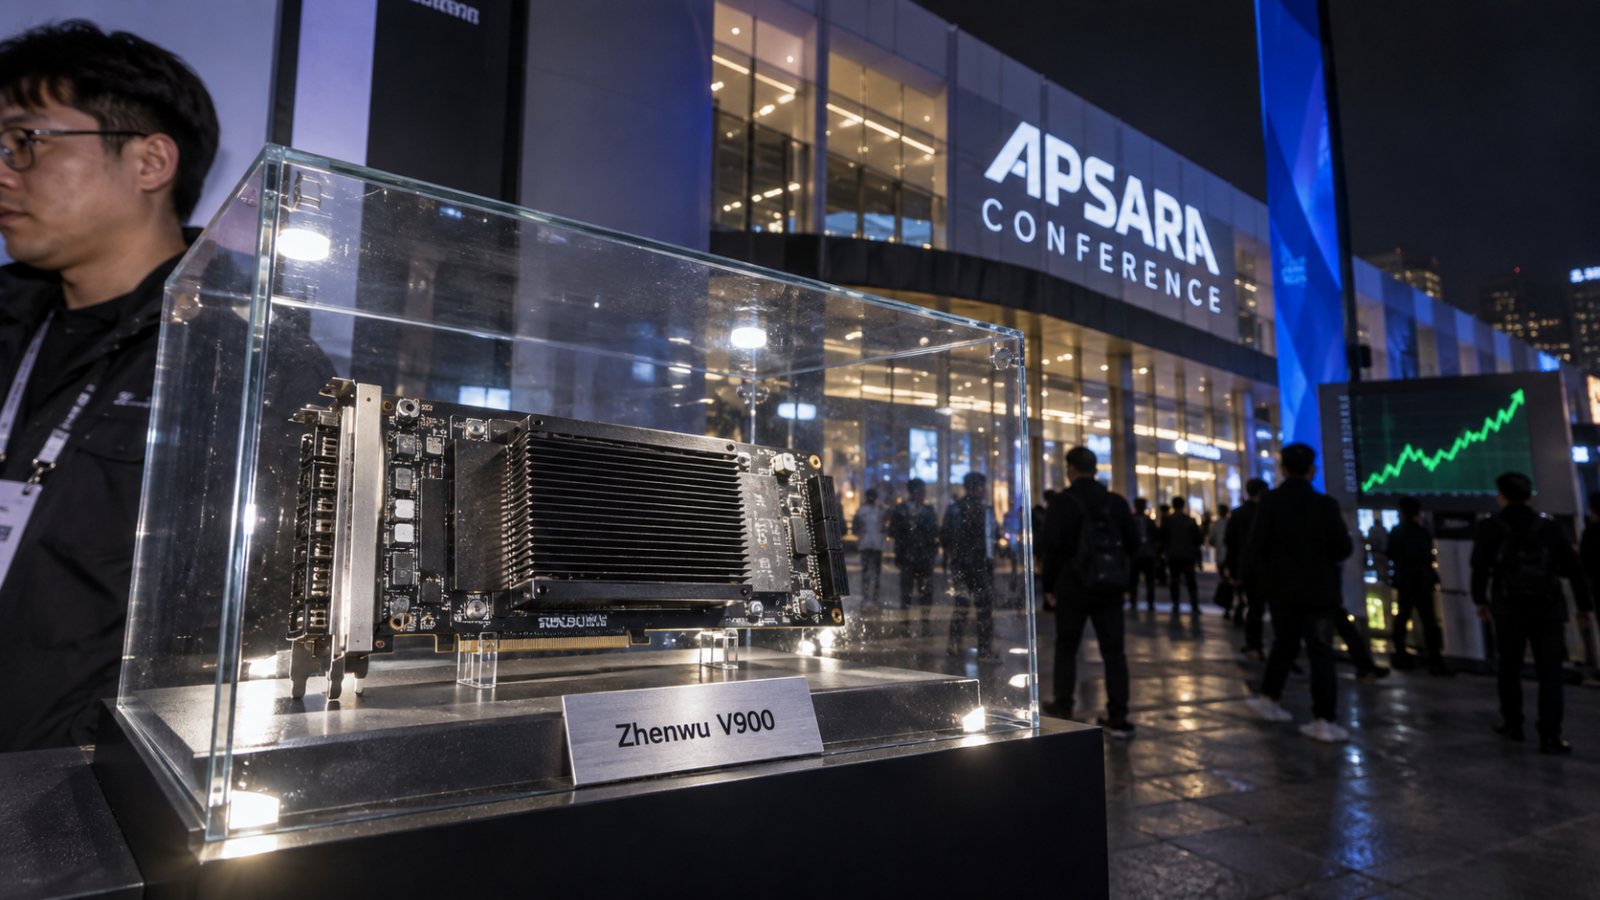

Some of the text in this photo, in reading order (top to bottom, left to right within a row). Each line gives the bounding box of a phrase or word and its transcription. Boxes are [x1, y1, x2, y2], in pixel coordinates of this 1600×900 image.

[982, 198, 1221, 313] CONFERENCE
[984, 121, 1220, 276] APSARA
[615, 709, 775, 748] Zhenwu V900
